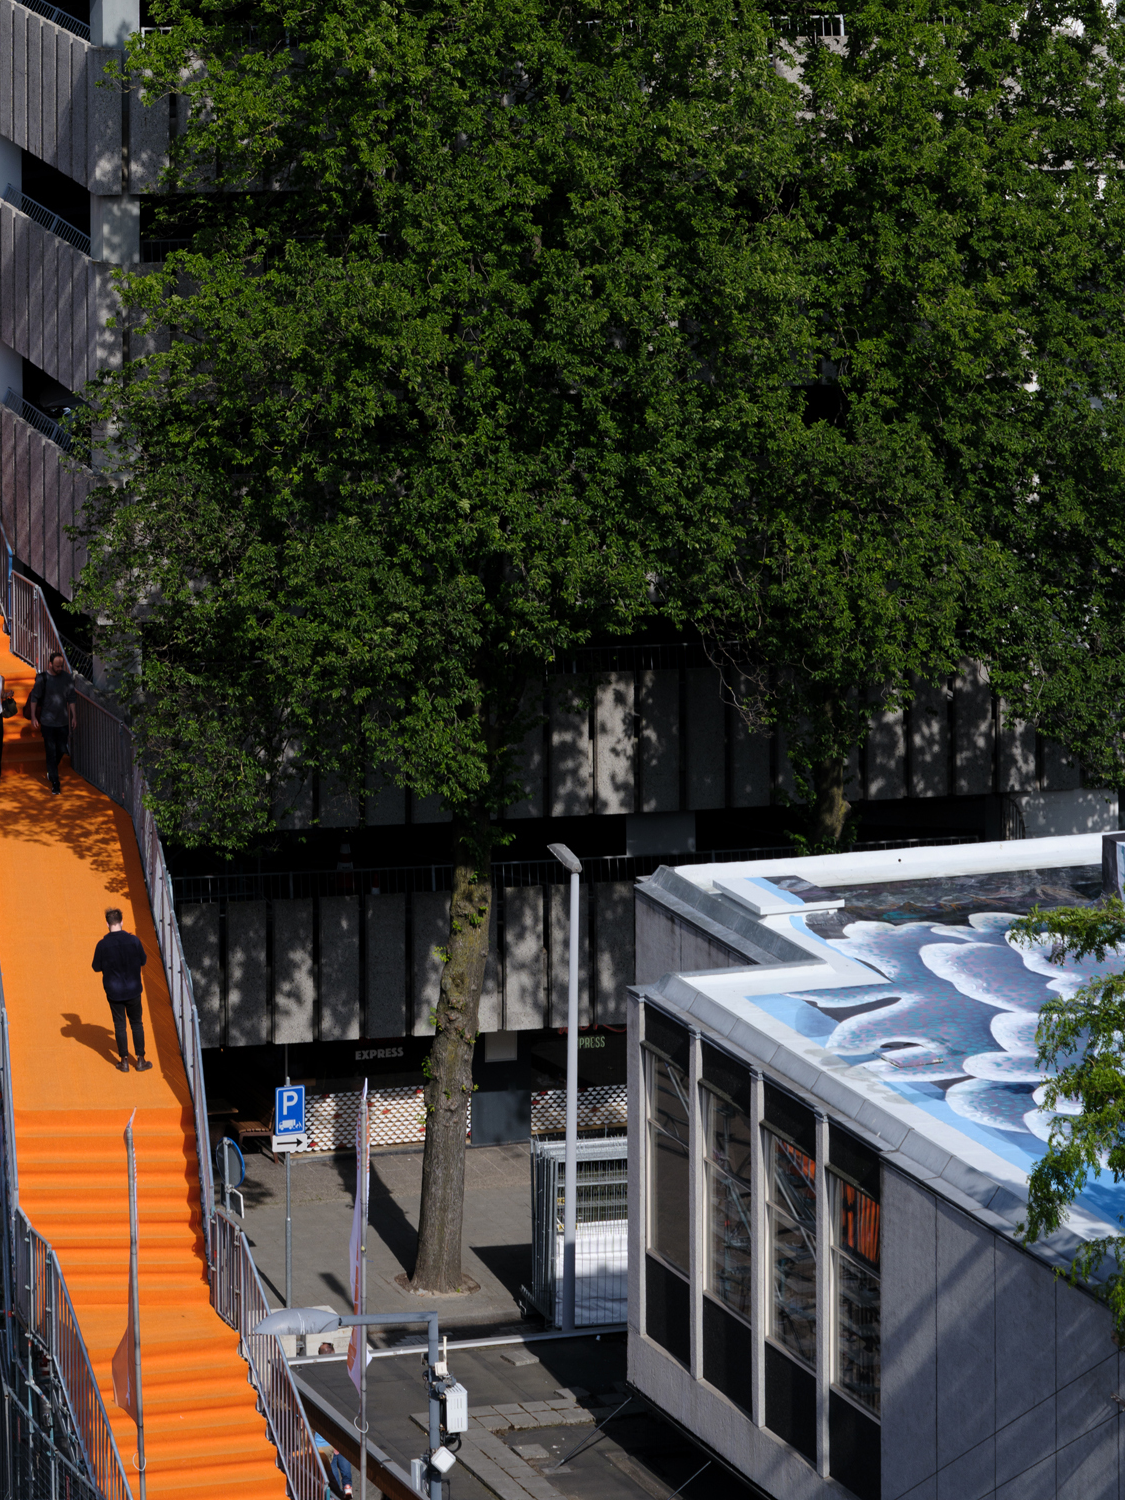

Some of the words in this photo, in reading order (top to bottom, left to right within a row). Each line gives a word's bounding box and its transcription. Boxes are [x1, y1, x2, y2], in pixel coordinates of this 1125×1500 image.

[579, 1036, 605, 1049] PRESS
[355, 1047, 404, 1060] EXPRESS
[283, 1091, 298, 1115] P
